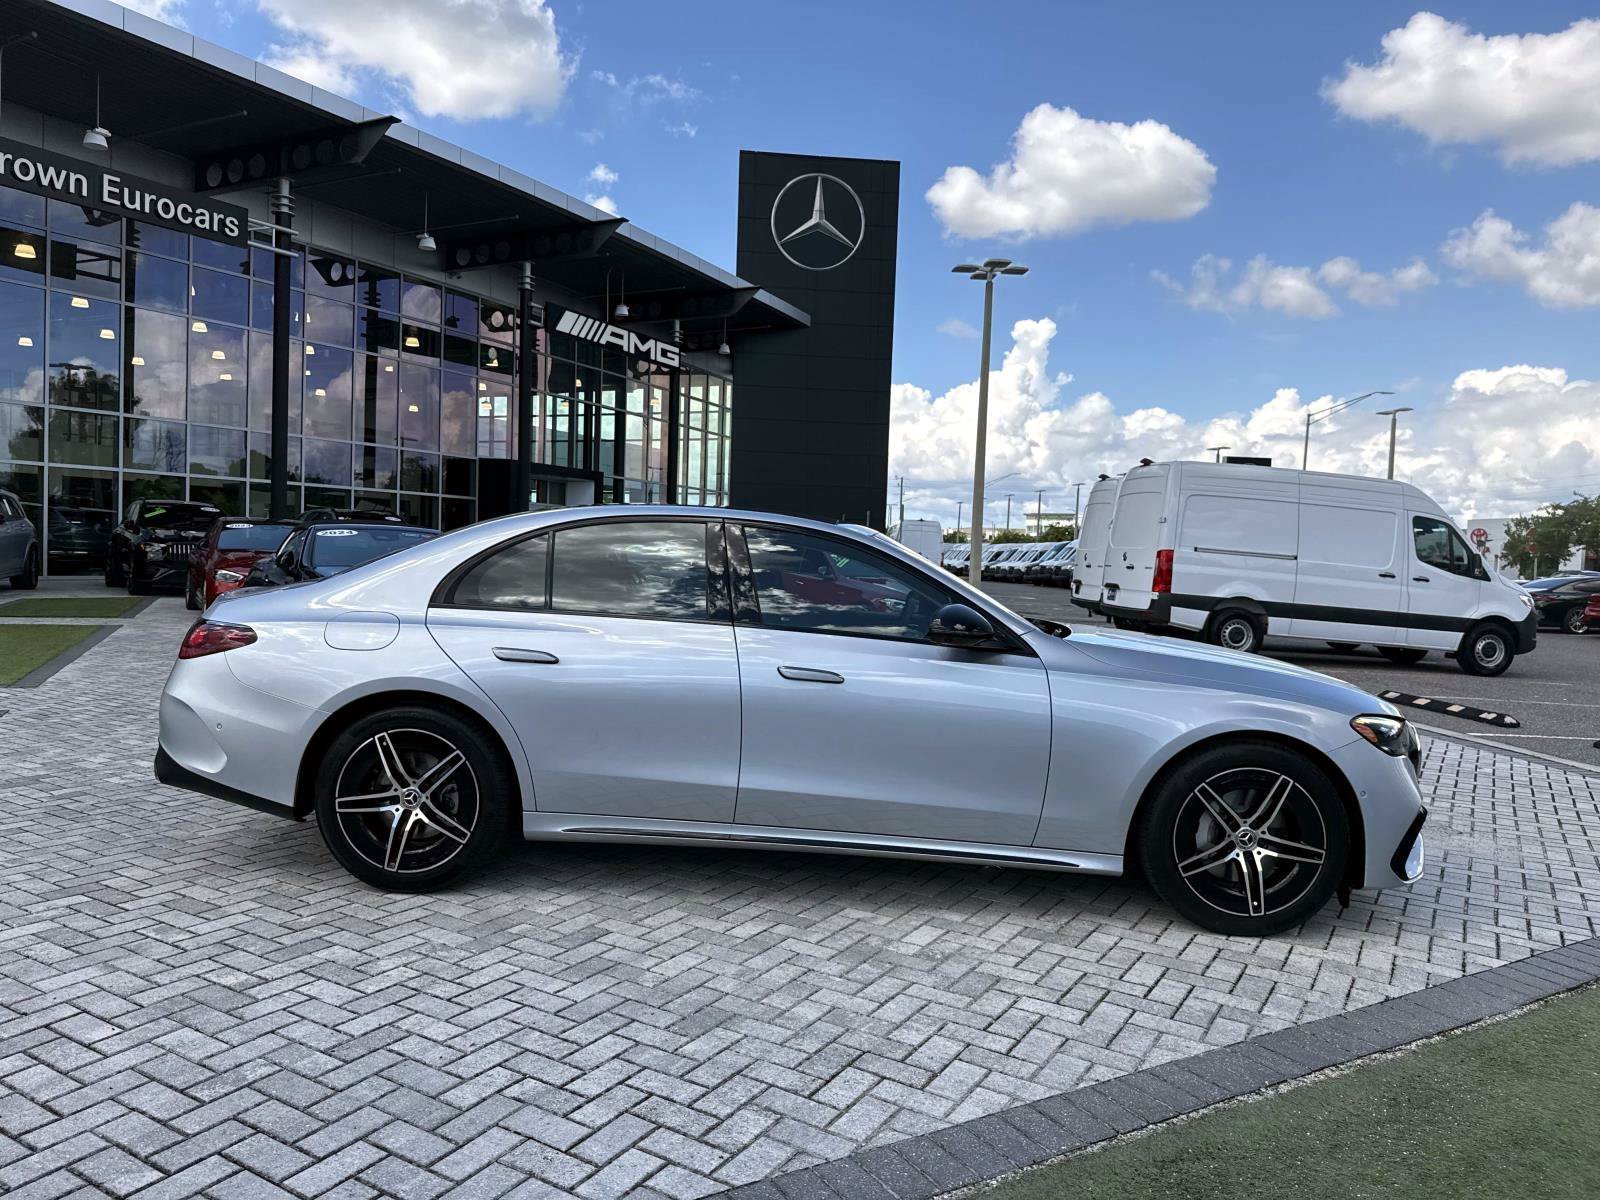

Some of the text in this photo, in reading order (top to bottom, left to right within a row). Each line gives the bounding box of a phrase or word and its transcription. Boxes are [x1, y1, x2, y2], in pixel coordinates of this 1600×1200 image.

[0, 152, 239, 237] rown Eurocars
[598, 324, 680, 368] AMG
